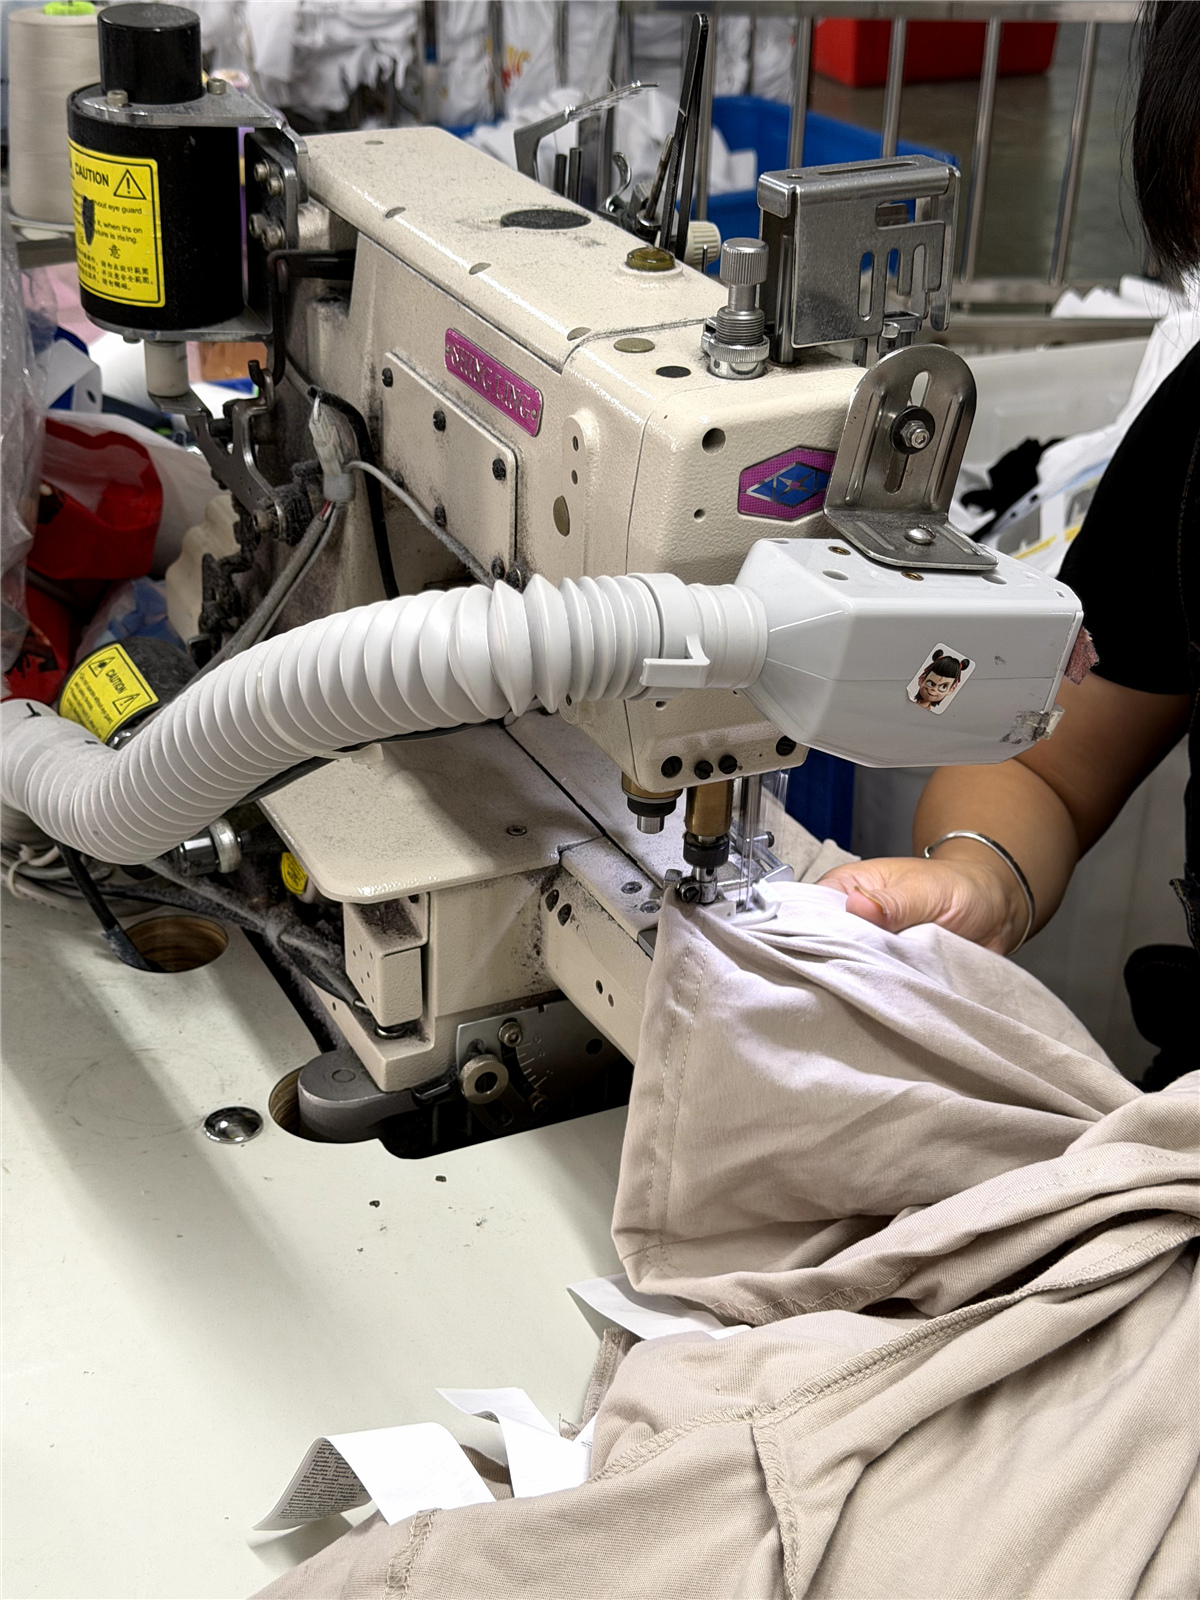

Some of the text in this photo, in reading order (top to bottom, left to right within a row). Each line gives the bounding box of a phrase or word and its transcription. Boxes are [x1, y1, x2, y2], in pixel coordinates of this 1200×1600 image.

[74, 162, 110, 188] CAUTION
[121, 207, 142, 215] guard
[495, 375, 531, 420] LING
[105, 669, 128, 694] CAUTION
